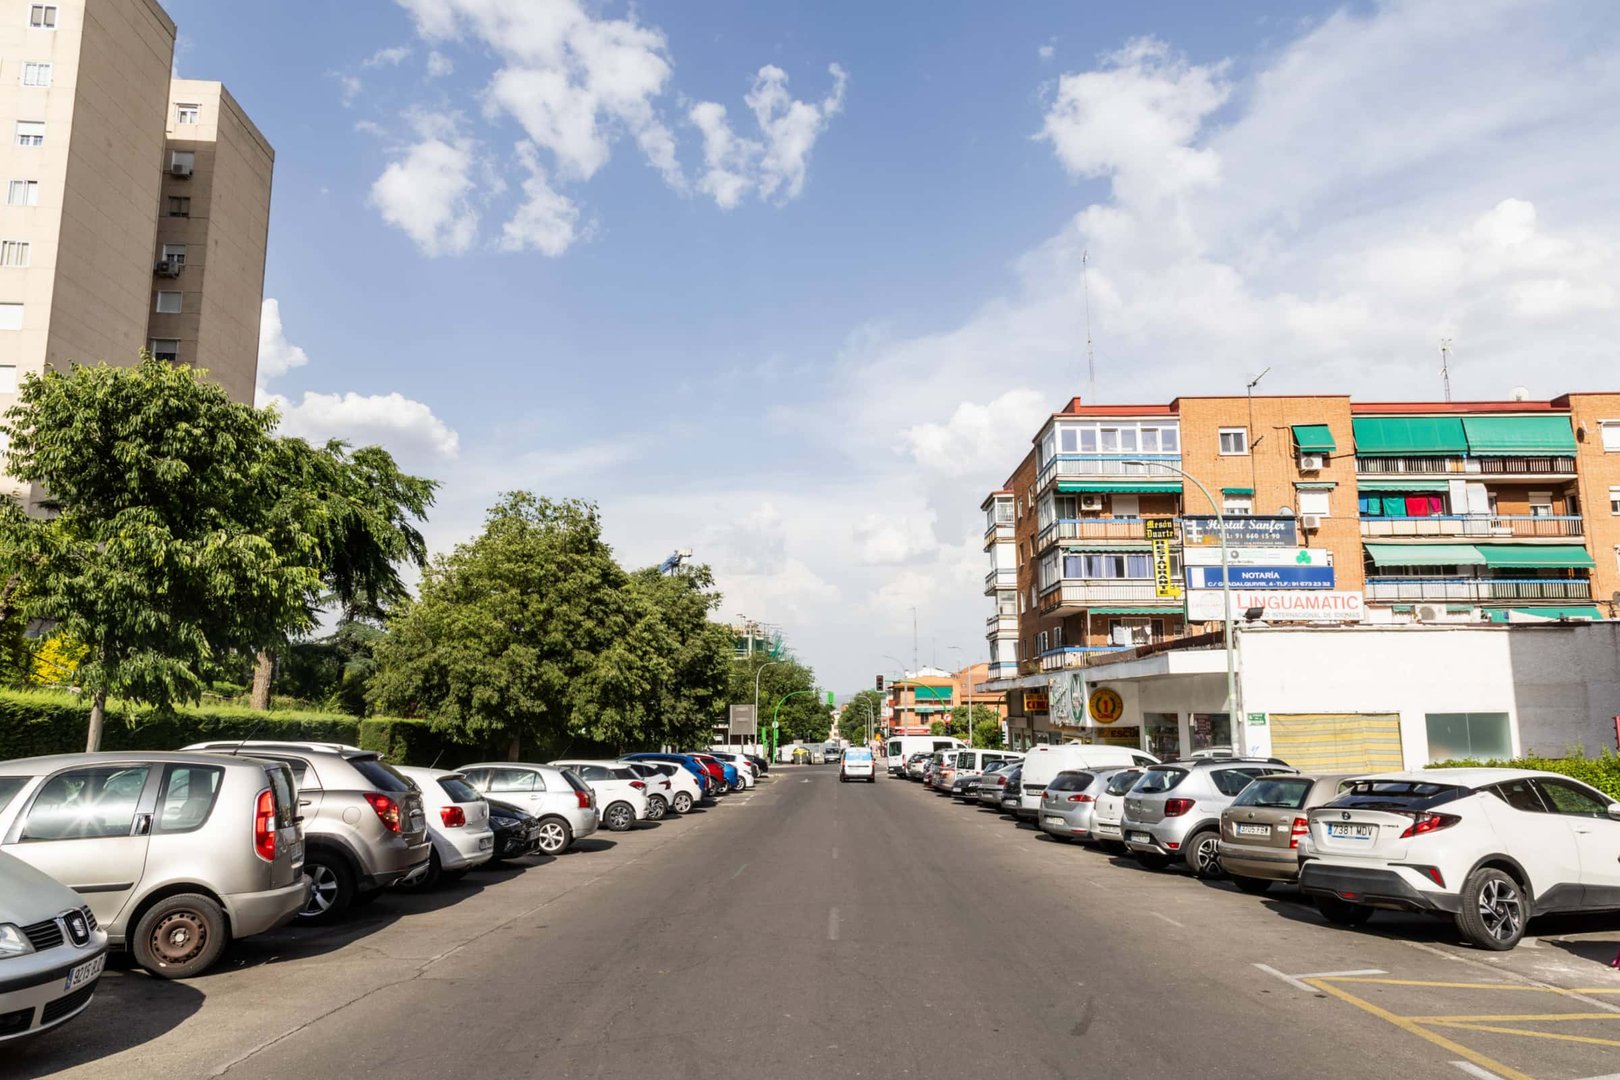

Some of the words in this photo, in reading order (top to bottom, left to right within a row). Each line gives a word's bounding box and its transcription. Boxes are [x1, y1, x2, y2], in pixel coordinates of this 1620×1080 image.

[1248, 519, 1286, 532] Sanfer
[1242, 571, 1280, 579] NOTARÍA
[1237, 593, 1359, 609] LINGUAMATIC
[1333, 824, 1353, 835] 7381
[1356, 826, 1373, 836] MDV
